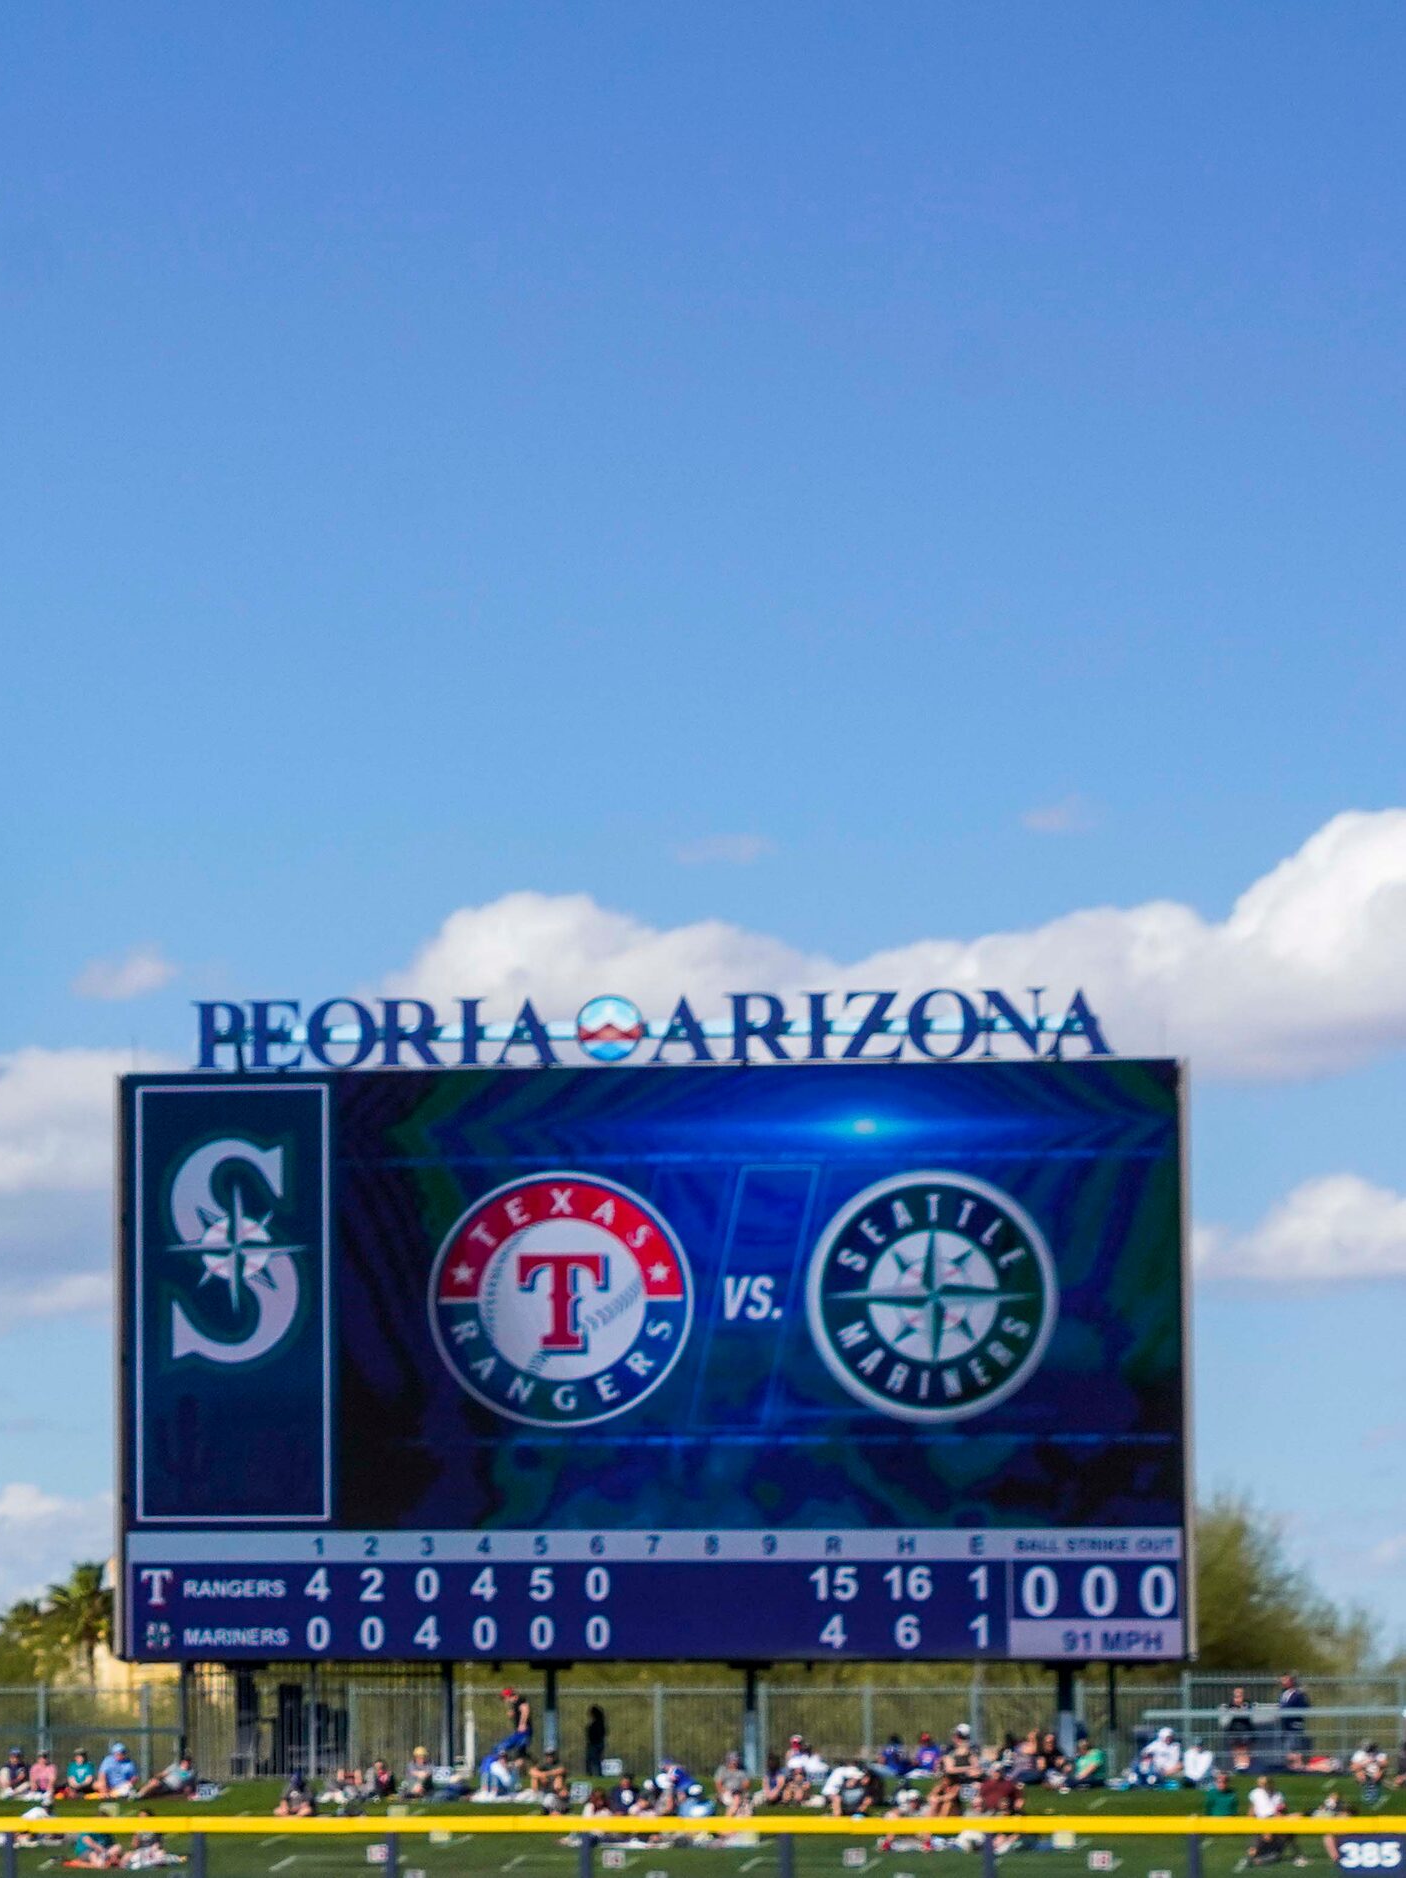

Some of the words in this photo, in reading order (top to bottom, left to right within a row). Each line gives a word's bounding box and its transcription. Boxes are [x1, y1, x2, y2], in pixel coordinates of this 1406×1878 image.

[193, 996, 561, 1069] PEORIA
[647, 987, 1113, 1062] ARIZONA
[468, 1188, 654, 1249] TEXAS
[837, 1193, 1026, 1272] SEATTLE
[516, 1254, 610, 1356] T
[723, 1275, 783, 1320] VS.
[451, 1320, 674, 1411] RANGERS
[836, 1316, 1032, 1399] MARINERS
[312, 1537, 325, 1556] 1
[365, 1536, 379, 1556] 2
[420, 1535, 436, 1556] 3
[477, 1535, 492, 1555] 4
[534, 1534, 549, 1555] 5
[590, 1534, 605, 1555] 6
[646, 1534, 662, 1555] 7
[704, 1534, 720, 1555] 8
[762, 1534, 778, 1555] 9
[825, 1535, 843, 1555] R
[897, 1535, 916, 1554] H
[969, 1535, 985, 1555] E
[1015, 1536, 1060, 1552] BALL
[1067, 1536, 1131, 1552] STRIKE
[1135, 1536, 1175, 1552] OUT
[140, 1568, 174, 1606] T
[183, 1580, 287, 1598] RANGERS
[304, 1567, 331, 1601] 4
[359, 1567, 385, 1602] 2
[415, 1567, 440, 1602] 0
[470, 1567, 498, 1601] 4
[528, 1567, 554, 1601] 5
[585, 1566, 610, 1601] 0
[809, 1566, 859, 1601] 15
[883, 1566, 933, 1601] 16
[968, 1566, 989, 1600] 1
[1021, 1565, 1059, 1617] 0
[1081, 1565, 1118, 1617] 0
[1139, 1565, 1177, 1617] 0
[183, 1628, 290, 1647] MARINERS
[306, 1616, 331, 1651] 0
[360, 1616, 385, 1651] 0
[413, 1615, 441, 1650] 4
[472, 1615, 498, 1650] 0
[530, 1615, 555, 1650] 0
[585, 1615, 611, 1650] 0
[819, 1614, 848, 1649] 4
[895, 1614, 921, 1650] 6
[968, 1614, 989, 1649] 1
[1062, 1630, 1092, 1651] 91
[1100, 1630, 1164, 1651] MPH
[1338, 1841, 1402, 1868] 385
